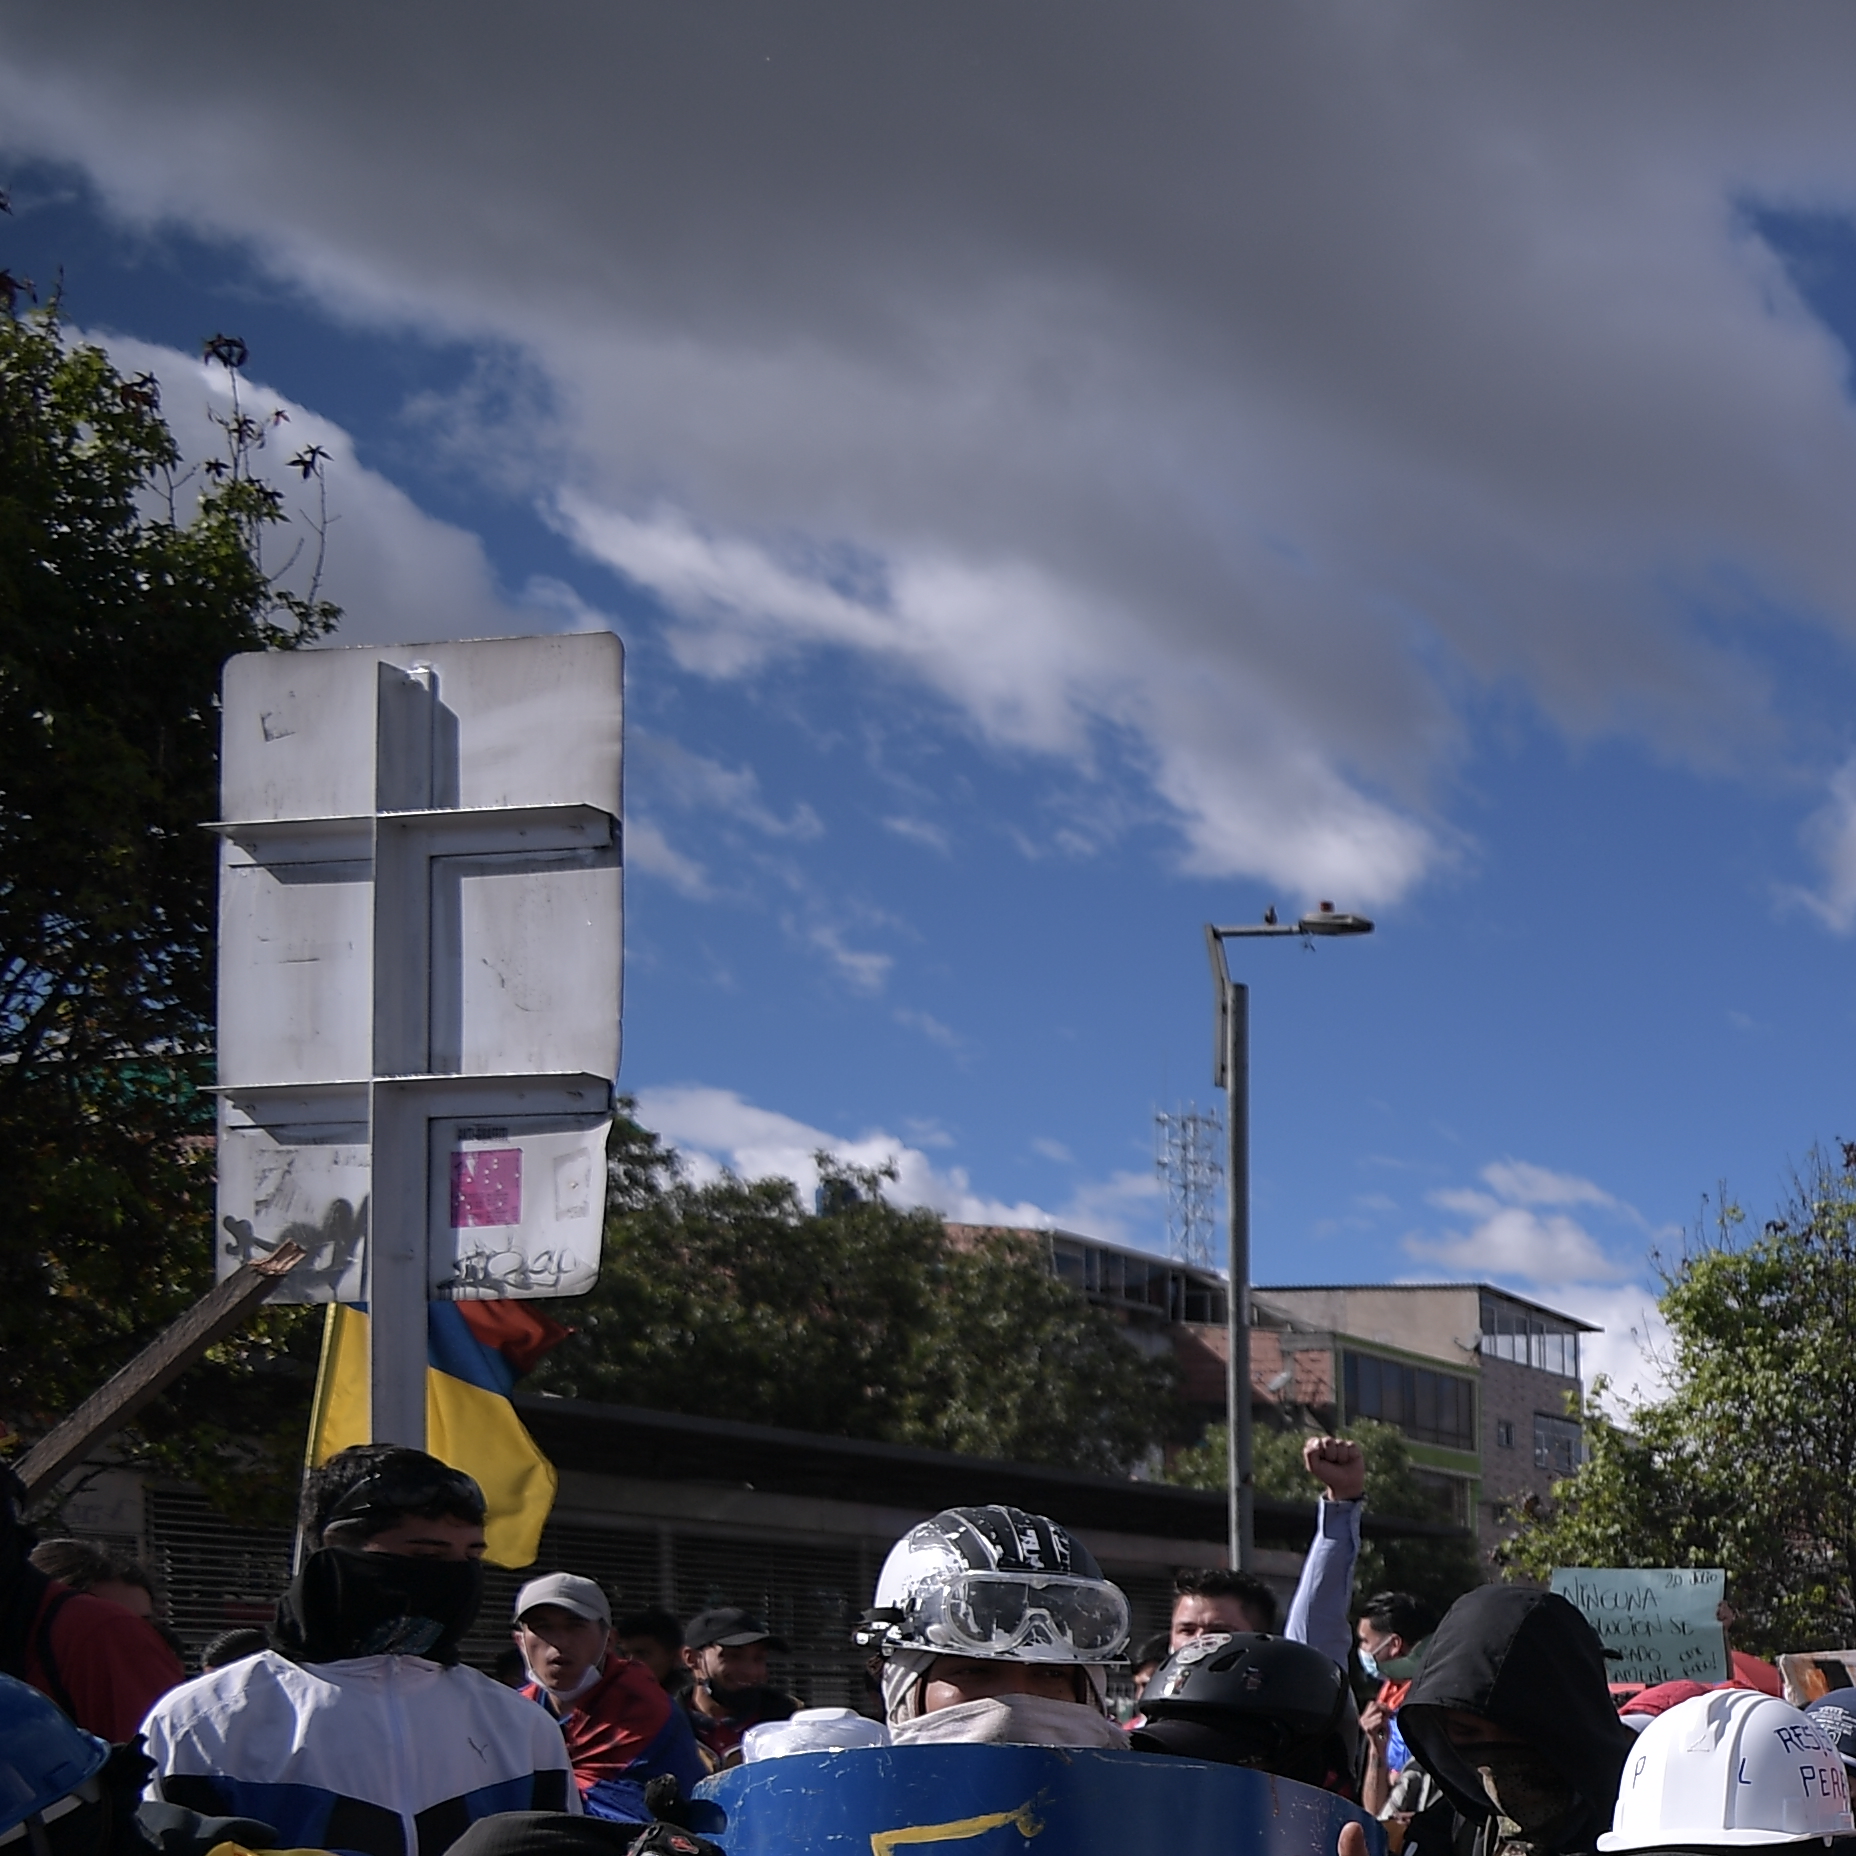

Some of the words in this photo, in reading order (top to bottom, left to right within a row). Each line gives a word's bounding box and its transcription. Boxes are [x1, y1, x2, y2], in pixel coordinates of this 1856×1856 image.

[1669, 1615, 1694, 1637] SE
[1632, 1755, 1647, 1790] P
[1738, 1757, 1752, 1784] L
